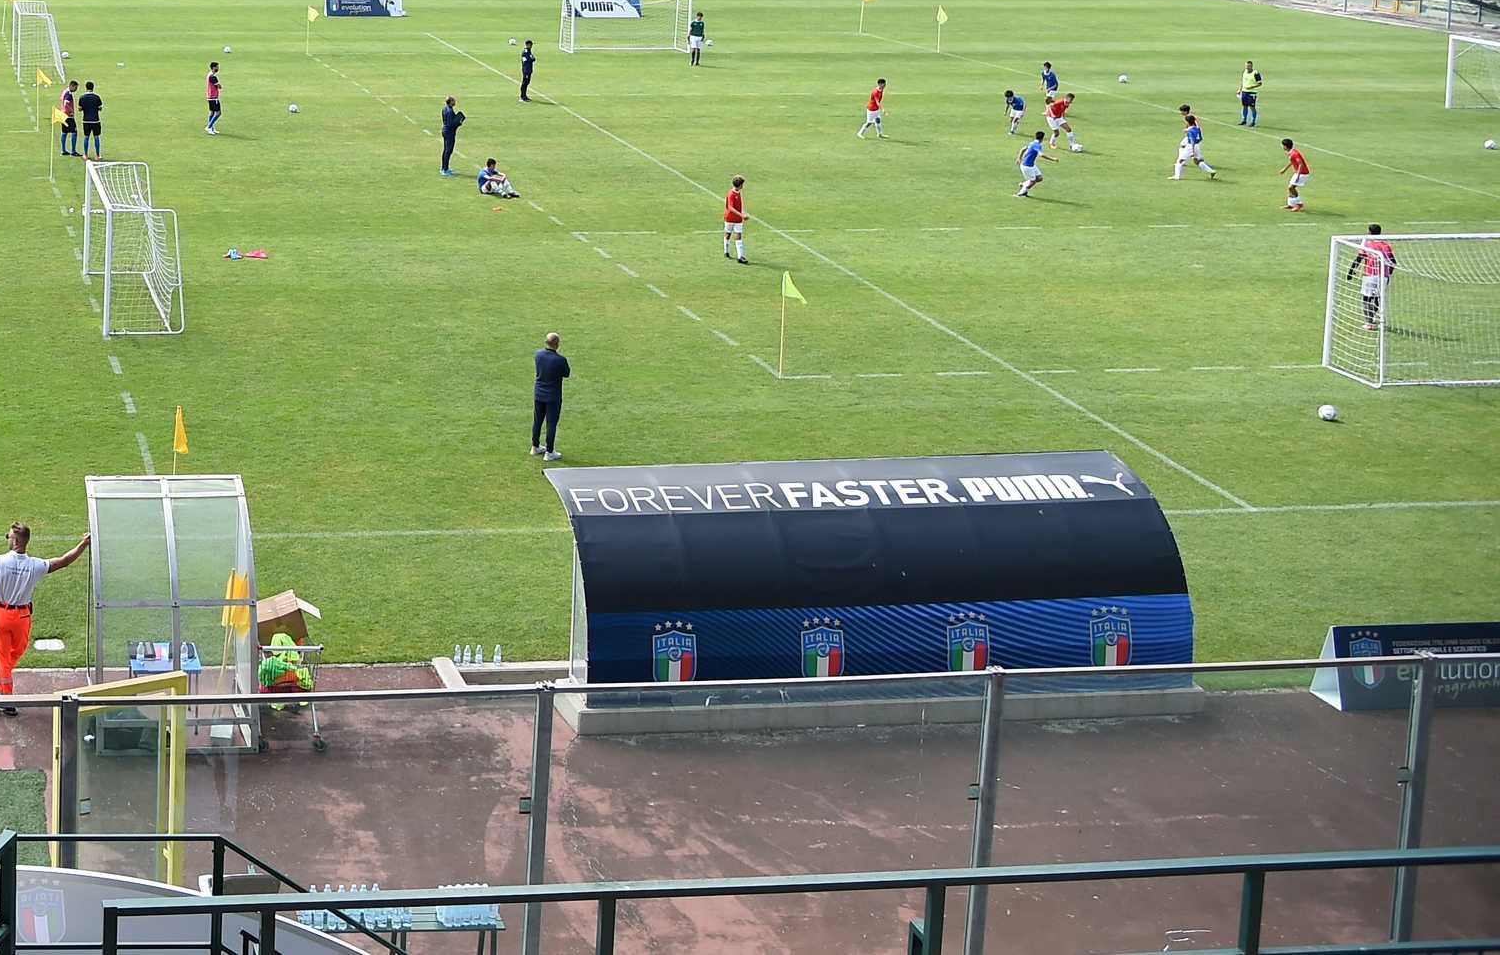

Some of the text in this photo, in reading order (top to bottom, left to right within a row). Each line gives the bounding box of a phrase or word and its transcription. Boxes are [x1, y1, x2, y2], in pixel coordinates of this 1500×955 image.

[580, 1, 614, 12] PUMA
[569, 482, 783, 513] FOREVER
[1093, 622, 1127, 632] ITALIA
[804, 632, 840, 644] ITALIA
[950, 628, 985, 639] ITALIA
[656, 637, 692, 648] ITALIA
